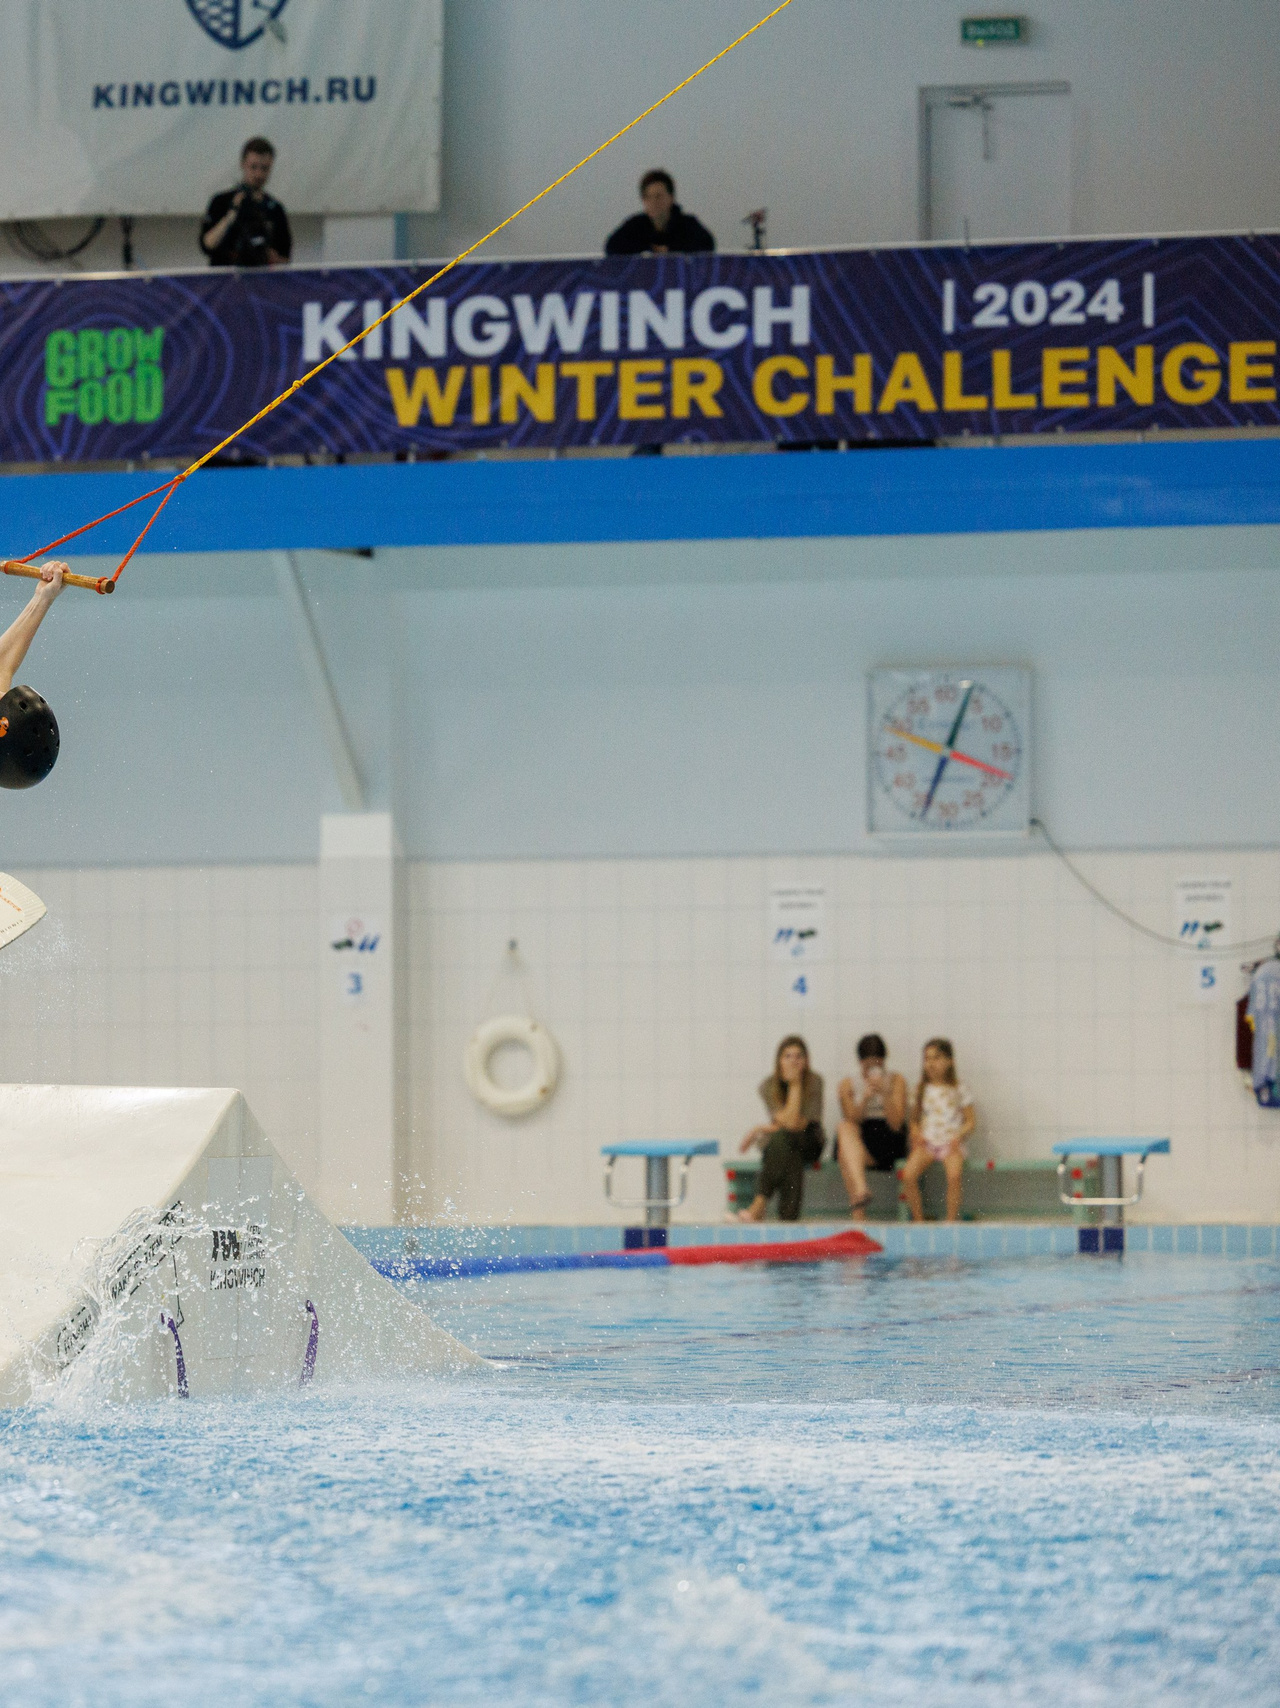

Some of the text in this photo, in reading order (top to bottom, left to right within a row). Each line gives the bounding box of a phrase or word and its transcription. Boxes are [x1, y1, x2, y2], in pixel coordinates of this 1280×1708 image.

[92, 76, 376, 109] KINGWINCH.RU
[302, 279, 1123, 362] KINGWINCH 2024
[45, 326, 165, 388] GROW
[384, 341, 1277, 427] WINTER CHALLENGE
[45, 364, 164, 426] FOOD
[792, 975, 808, 996] 4
[1201, 966, 1216, 989] 5
